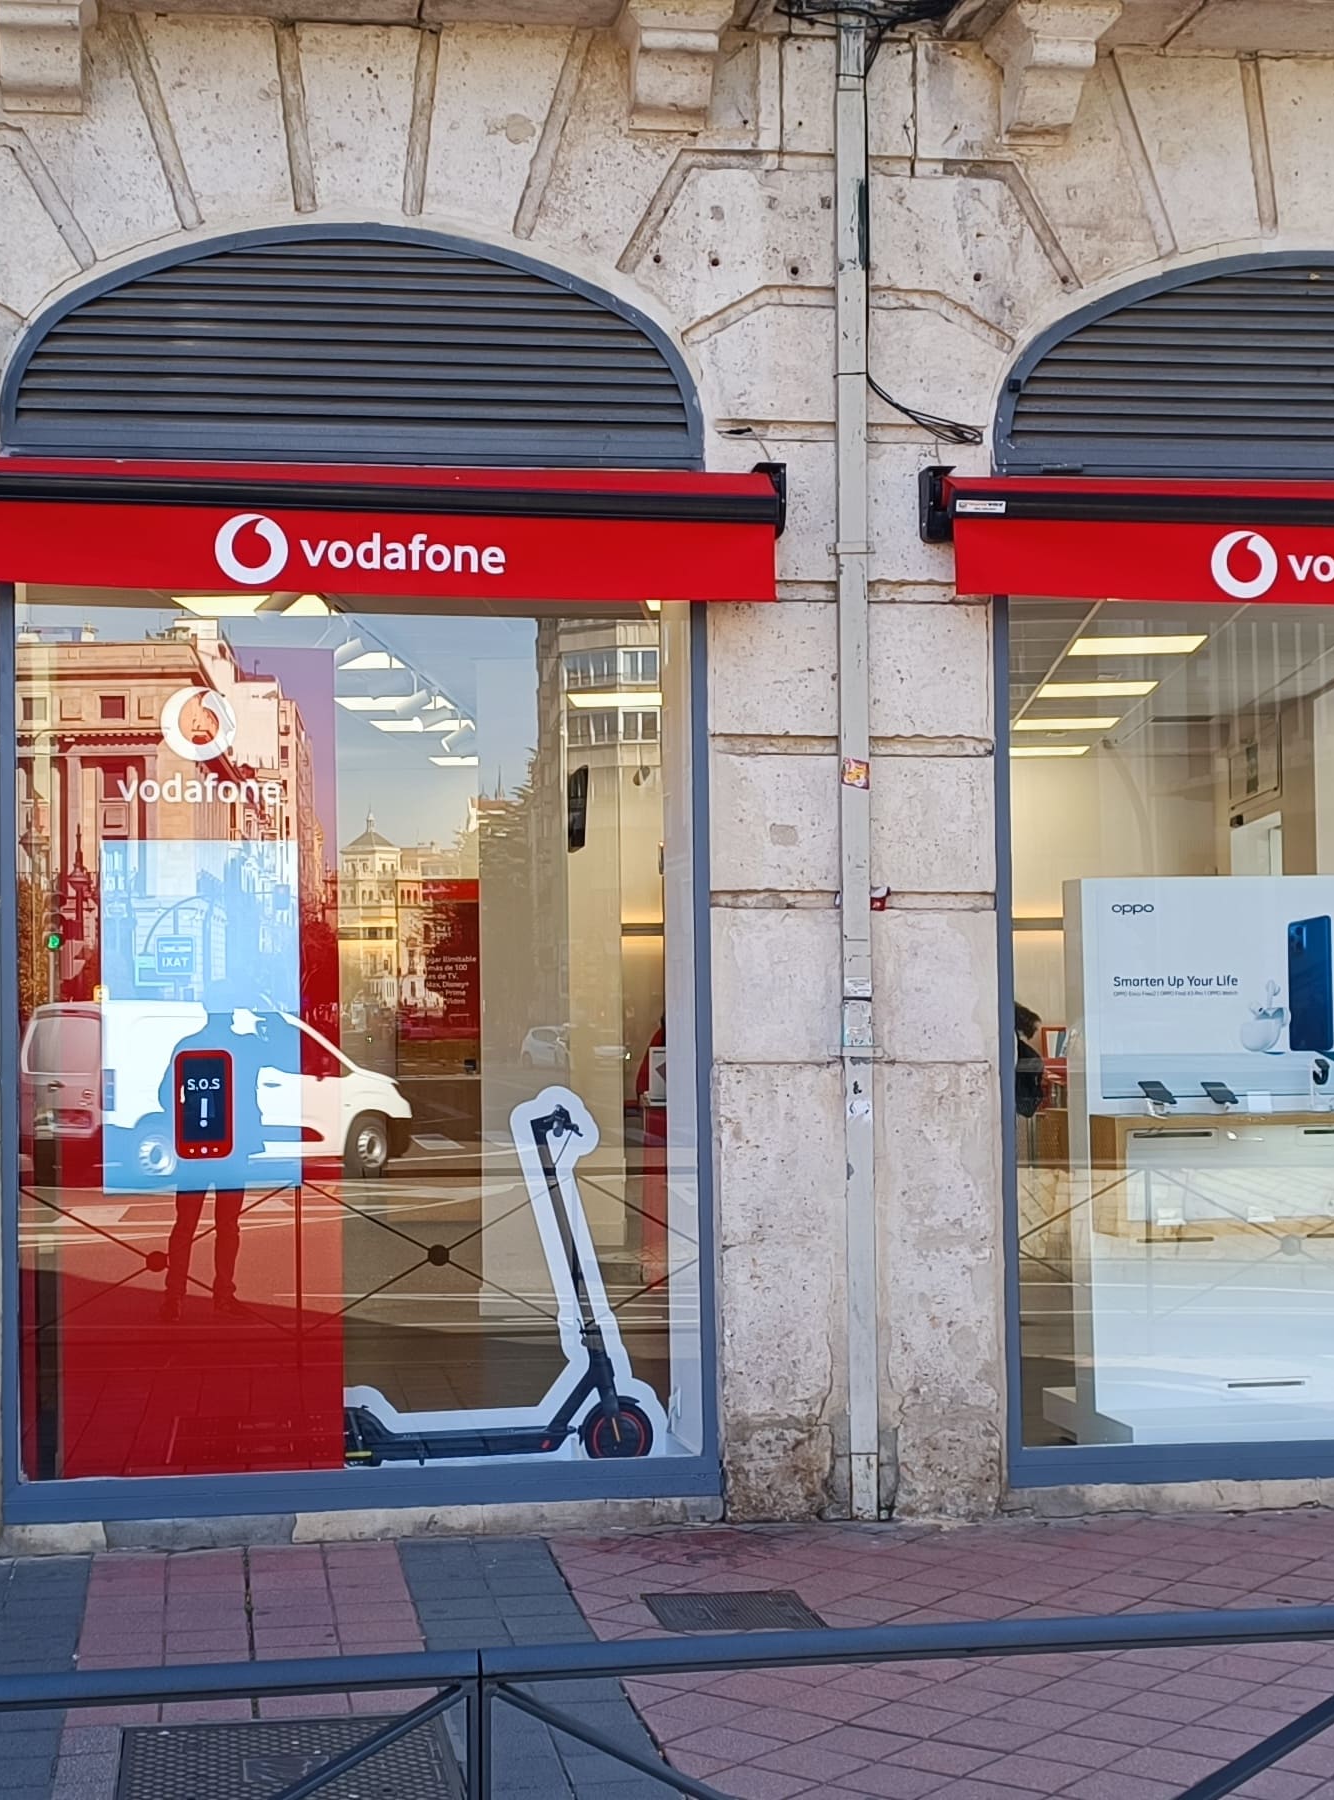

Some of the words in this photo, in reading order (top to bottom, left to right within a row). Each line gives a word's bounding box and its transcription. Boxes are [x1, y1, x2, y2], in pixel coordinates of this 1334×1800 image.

[300, 532, 506, 575] vodafone
[117, 771, 281, 805] vodafone
[1111, 903, 1155, 915] oppo
[1113, 976, 1165, 988] Smarten
[1167, 975, 1184, 989] Up
[1186, 975, 1214, 987] Your
[1216, 974, 1239, 987] Life
